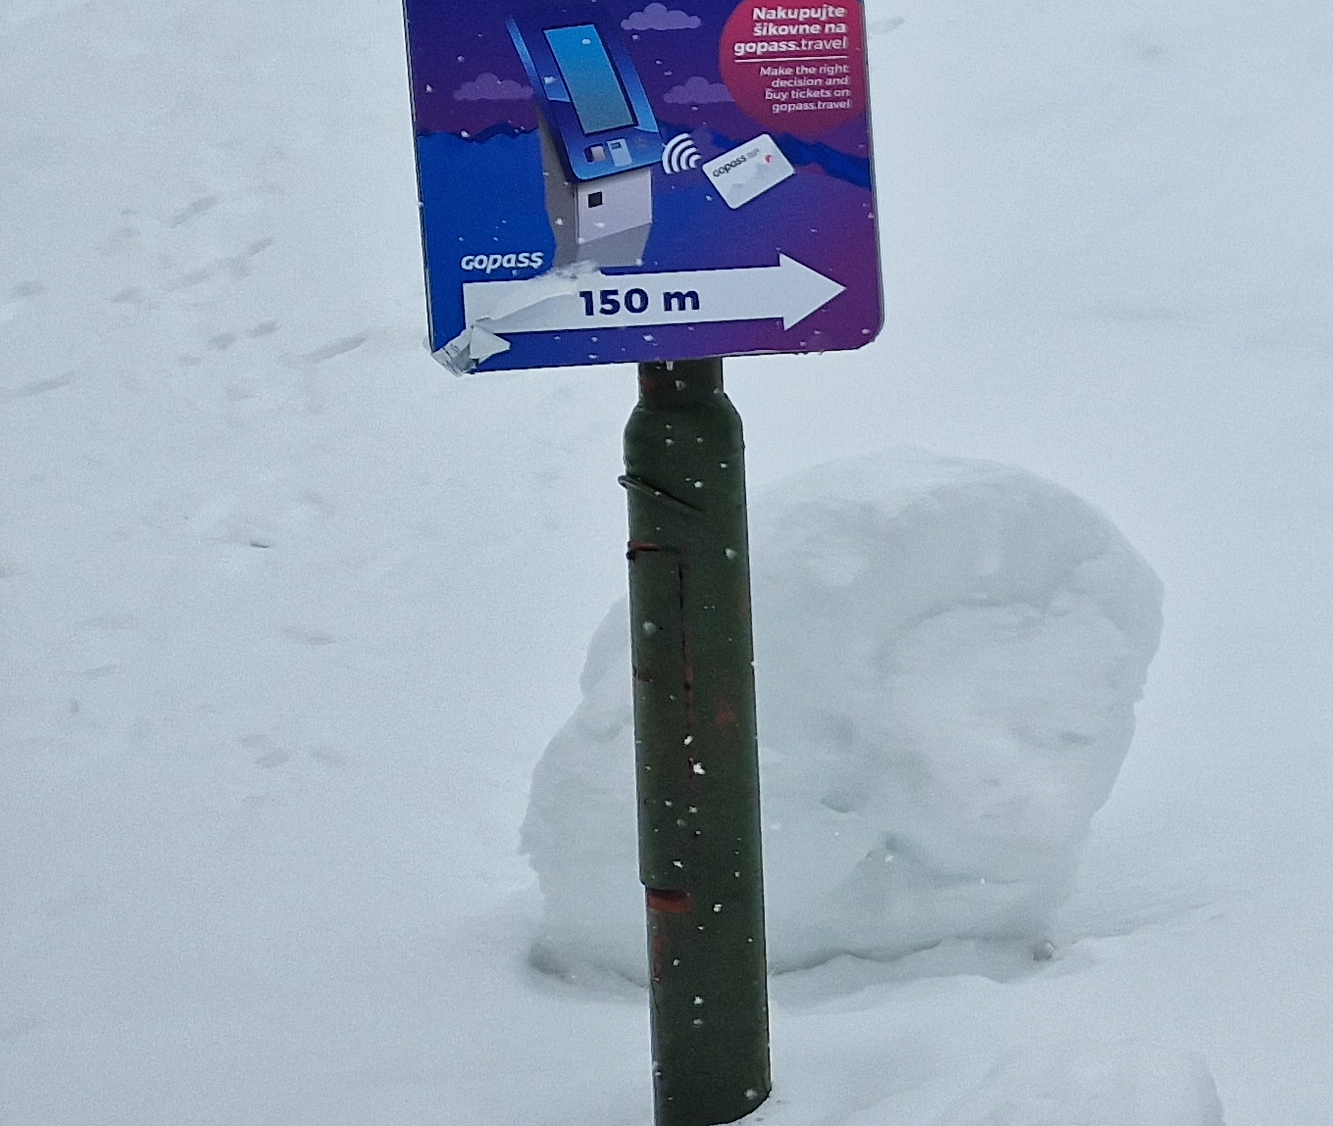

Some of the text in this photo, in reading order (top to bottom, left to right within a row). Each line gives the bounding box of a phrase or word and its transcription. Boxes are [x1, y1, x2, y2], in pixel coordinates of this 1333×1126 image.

[752, 4, 846, 21] Nakupujte
[753, 23, 847, 36] šikovne na
[734, 36, 847, 56] gopass.travel
[760, 64, 849, 77] Make the right
[772, 76, 849, 88] decision and
[766, 88, 789, 101] buy
[791, 88, 831, 98] tickets
[772, 101, 850, 114] gopass.travel
[579, 287, 700, 316] 150 m
